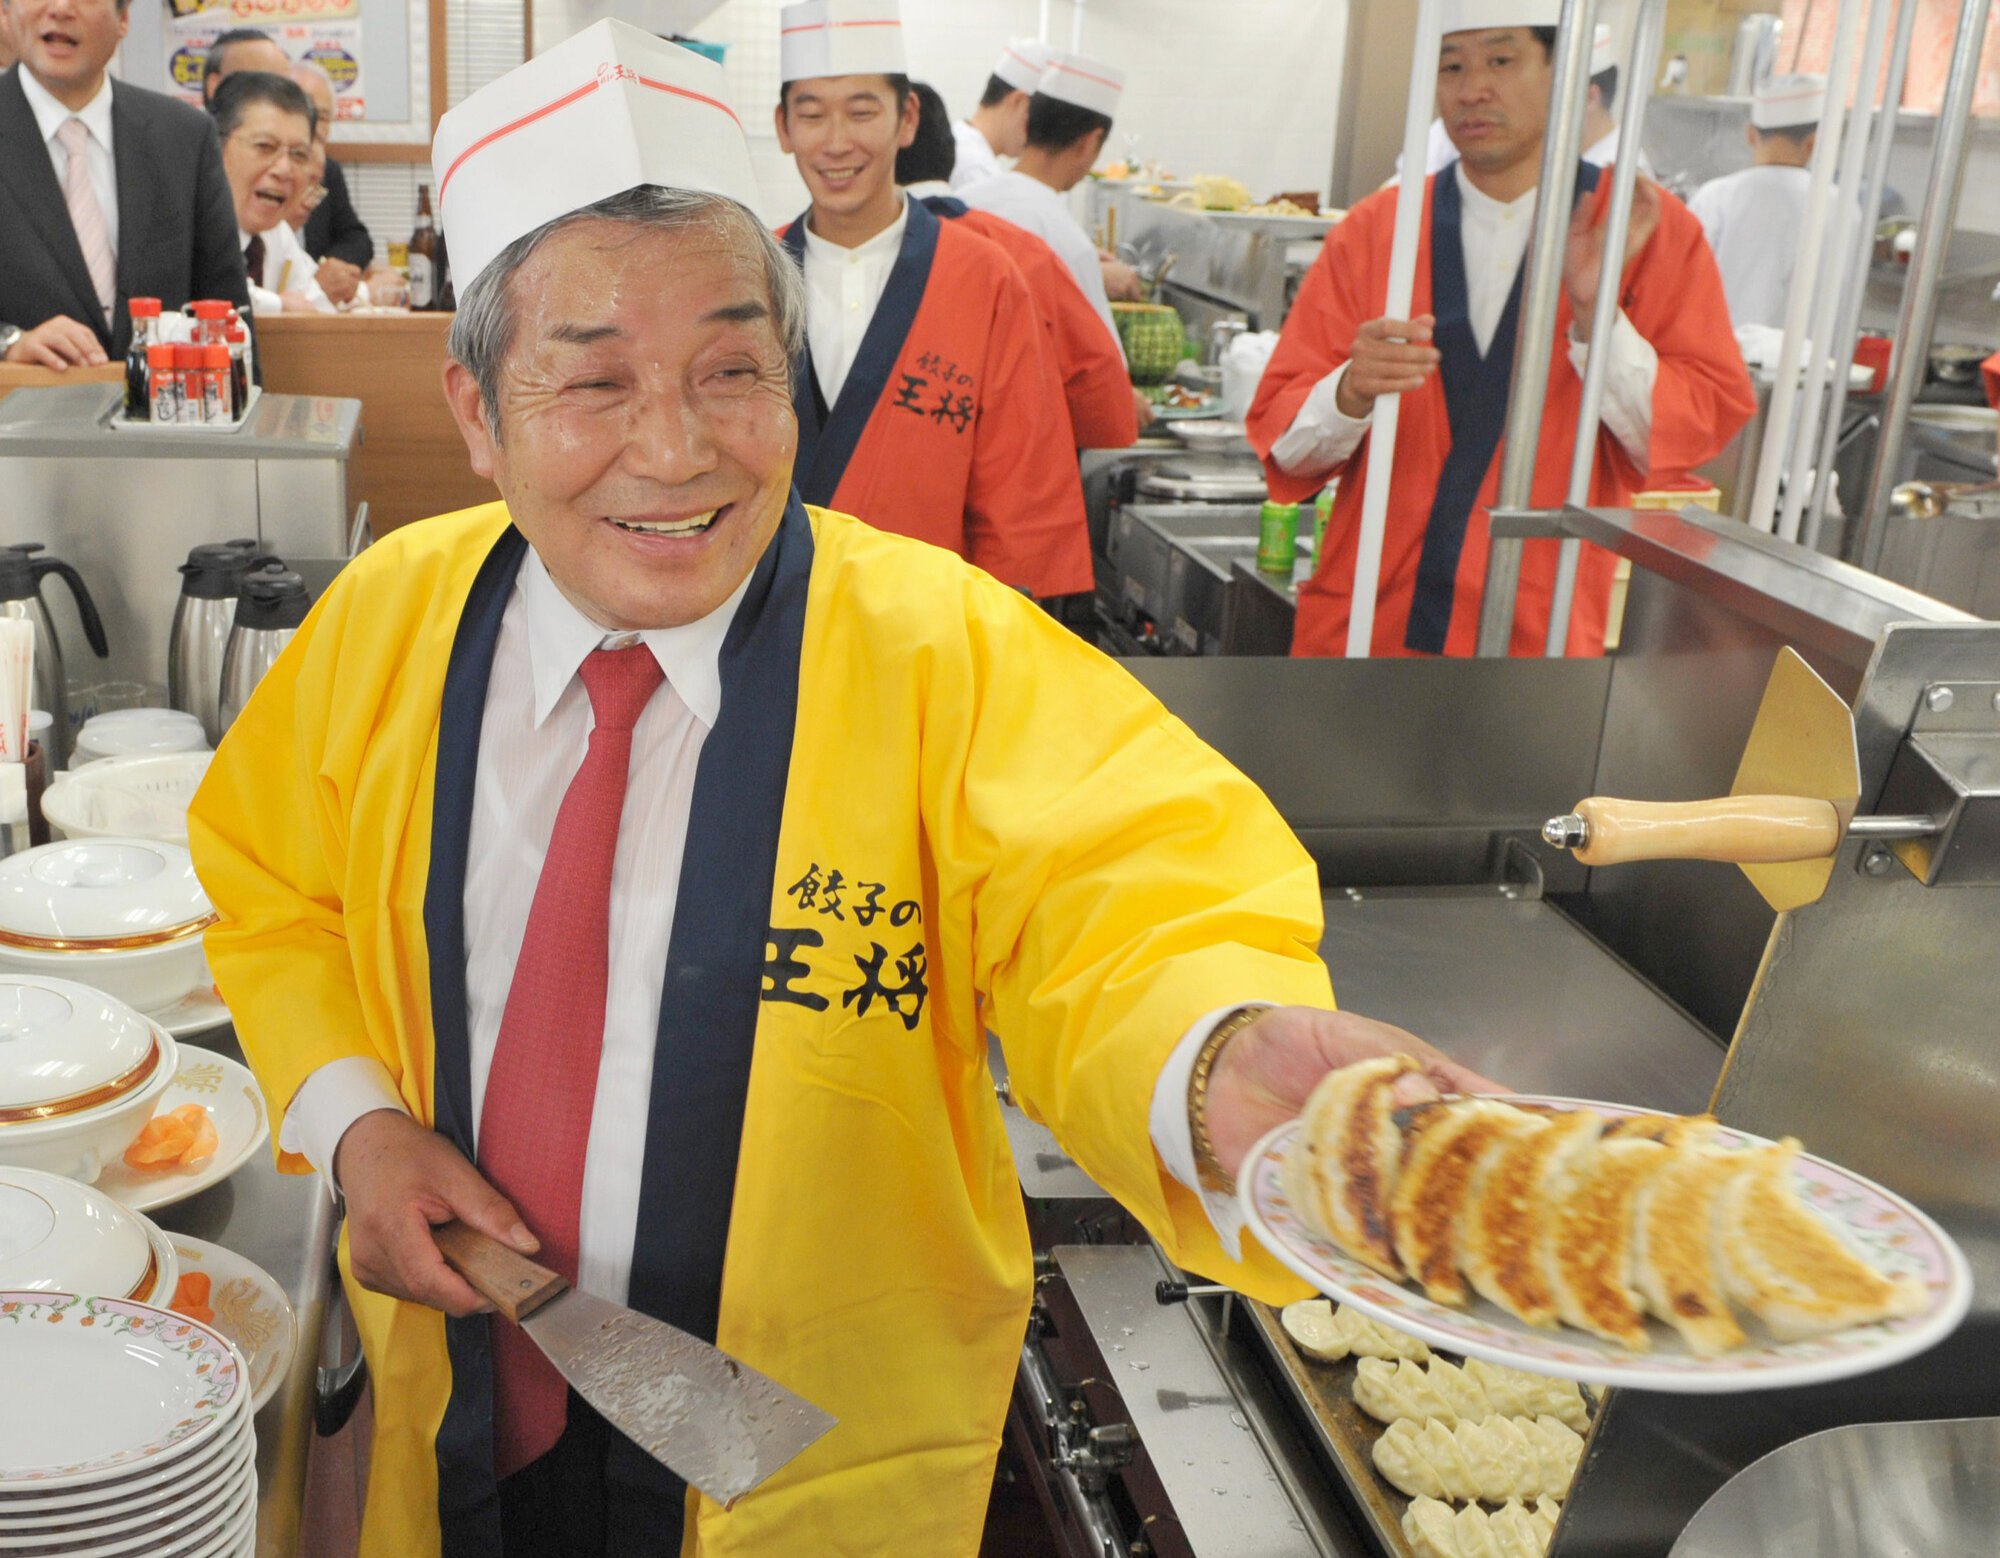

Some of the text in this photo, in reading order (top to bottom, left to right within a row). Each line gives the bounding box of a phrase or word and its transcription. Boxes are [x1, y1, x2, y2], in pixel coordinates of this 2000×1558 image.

[892, 373, 977, 434] 王将
[787, 862, 922, 927] 餃子の
[761, 926, 928, 1032] 王将
